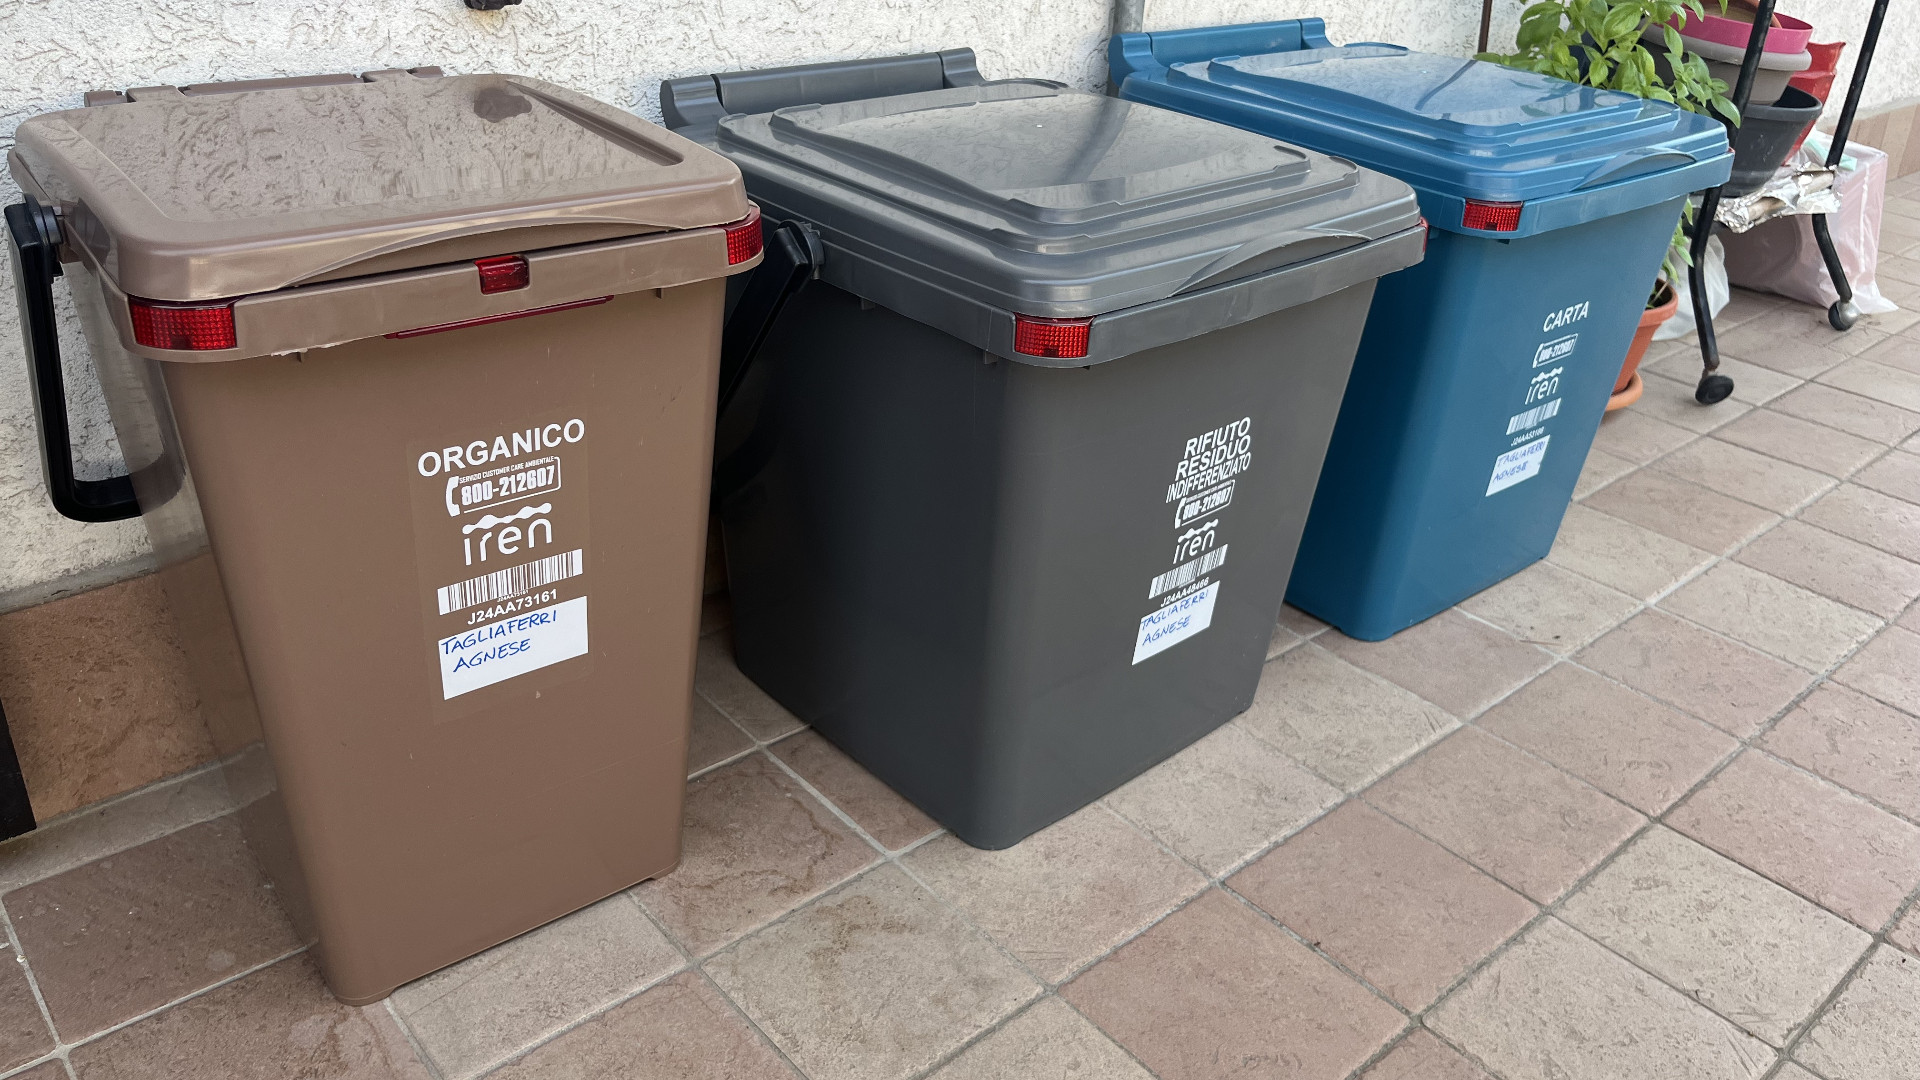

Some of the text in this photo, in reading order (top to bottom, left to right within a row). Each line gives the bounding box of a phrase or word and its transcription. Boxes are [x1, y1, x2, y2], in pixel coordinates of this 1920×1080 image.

[1543, 301, 1589, 332] CARTA
[1525, 376, 1558, 405] iren
[417, 418, 585, 477] ORGANICO
[1175, 434, 1251, 481] RESIDUO
[1184, 416, 1251, 459] RIFIUTO
[459, 455, 555, 484] SERVIZIO CUSTOMER CARE AMBIENTALE
[461, 465, 555, 506] 800-212607
[1165, 452, 1251, 503] INDIFFERENZIATO
[462, 518, 552, 566] iren
[1173, 529, 1215, 564] iren
[467, 588, 557, 625] J24AA73161
[1141, 589, 1209, 631] TAGLIAFERRI
[441, 610, 557, 654] TAGLIAFERRI
[1142, 615, 1191, 646] AGNESE
[453, 638, 531, 672] AGNESE
